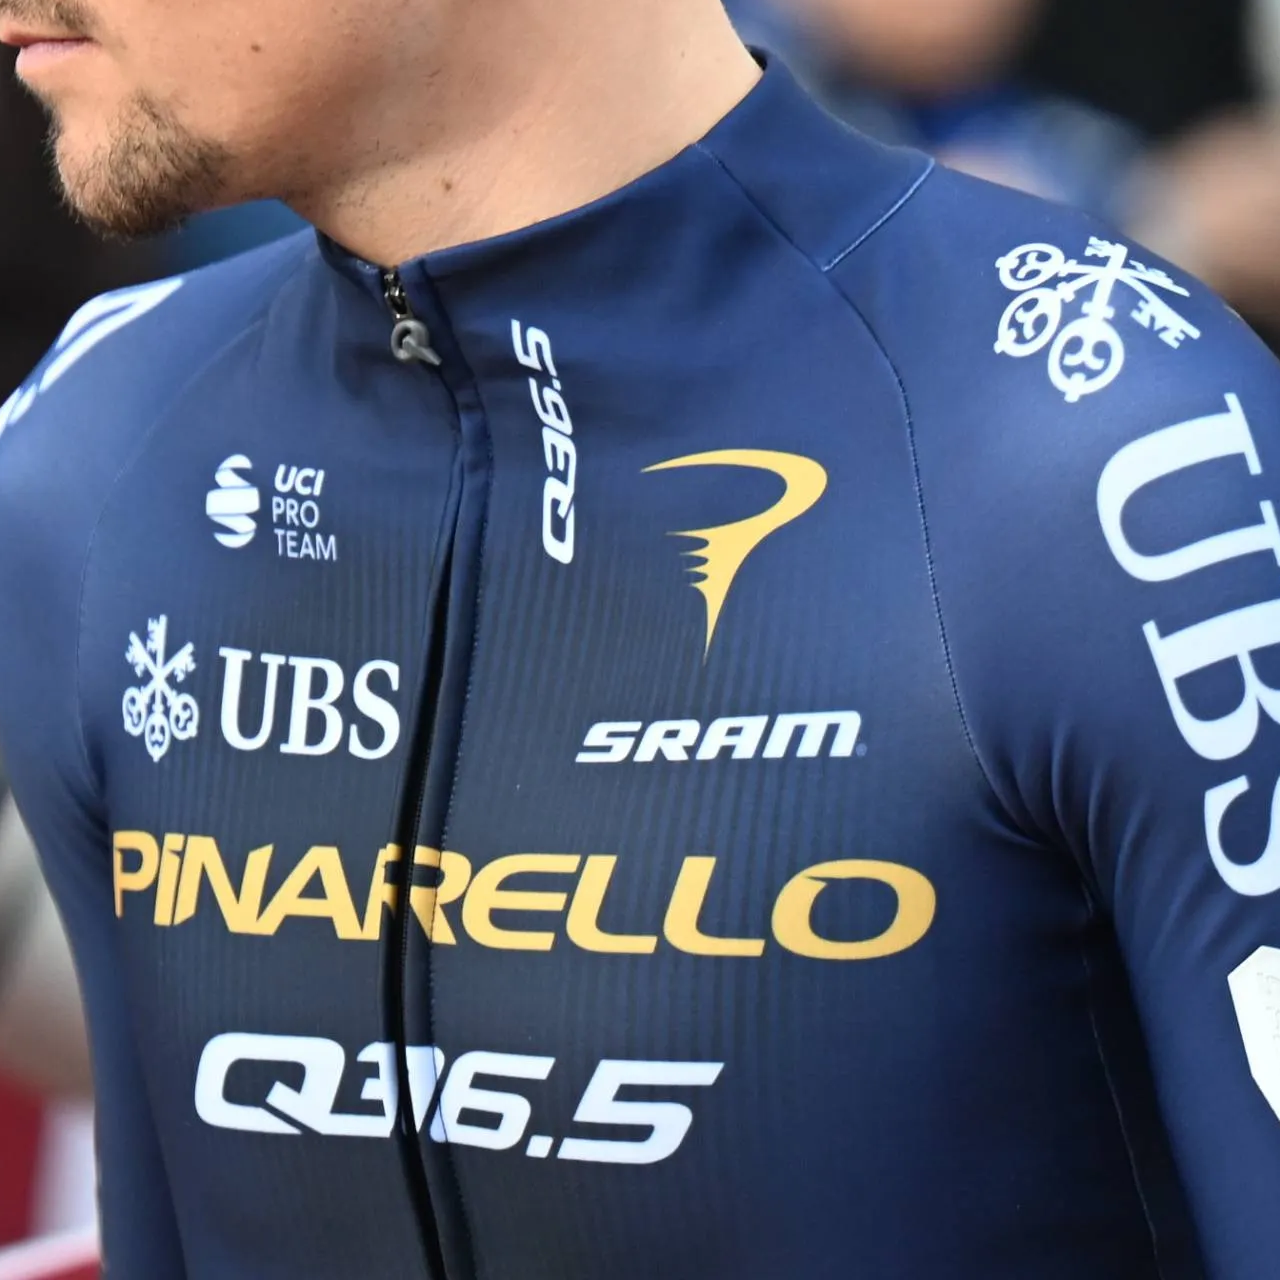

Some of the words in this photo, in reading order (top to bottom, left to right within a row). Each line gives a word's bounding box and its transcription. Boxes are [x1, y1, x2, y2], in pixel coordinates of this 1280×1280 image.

[511, 319, 577, 565] Q36.5
[274, 464, 325, 497] UCI
[272, 496, 320, 528] PRO
[274, 529, 338, 561] TEAM
[218, 646, 400, 760] UBS
[575, 710, 862, 764] SRAM
[195, 1032, 725, 1166] Q36.5
